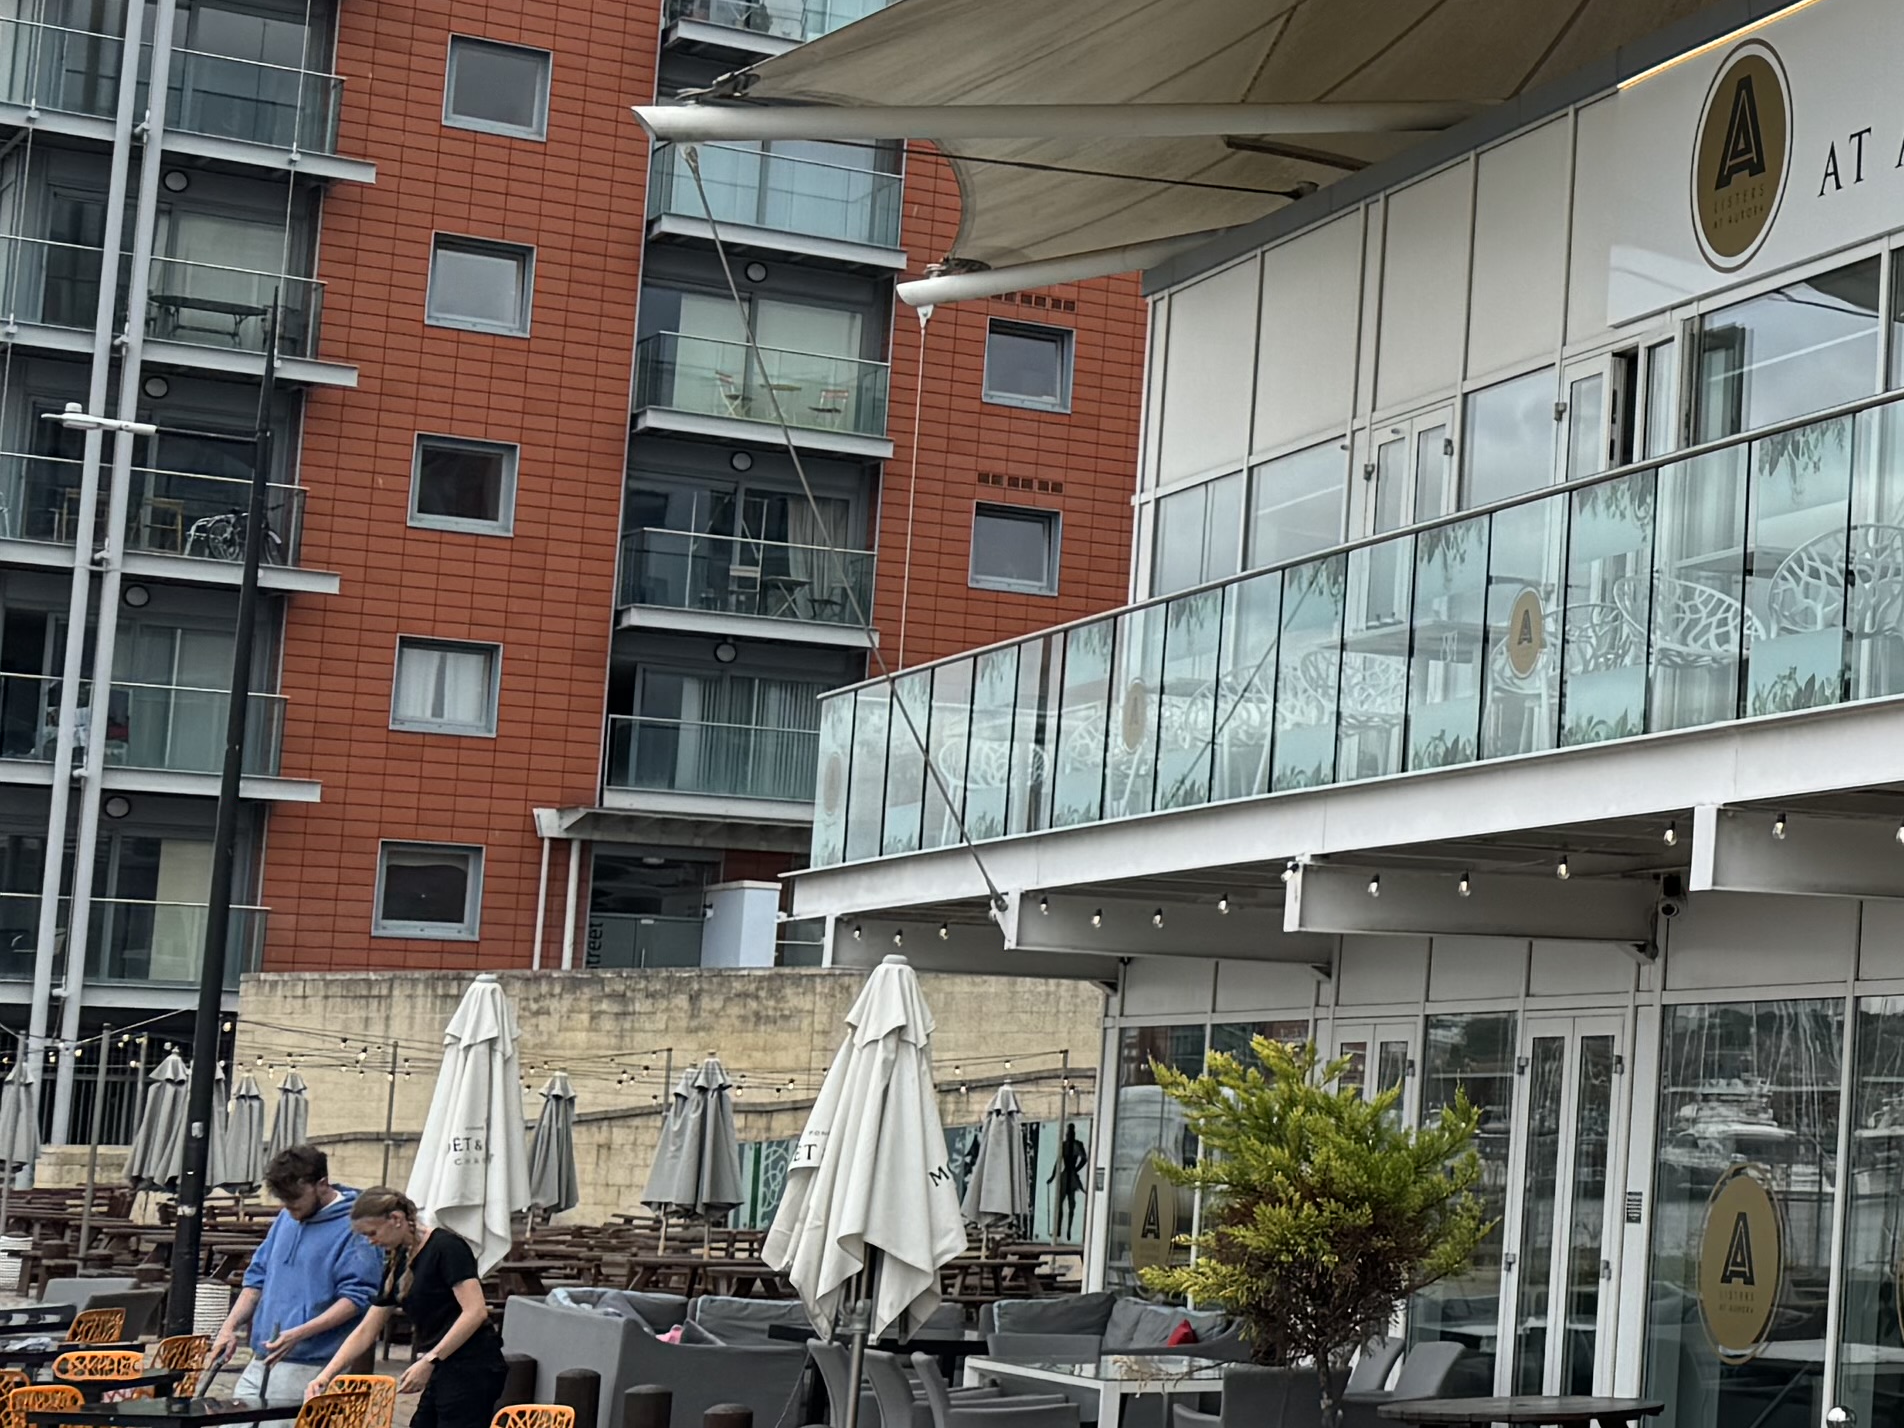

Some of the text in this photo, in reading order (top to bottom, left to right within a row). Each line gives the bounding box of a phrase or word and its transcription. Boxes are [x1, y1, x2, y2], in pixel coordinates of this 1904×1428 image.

[1714, 74, 1766, 191] A
[1817, 127, 1872, 198] AT
[586, 921, 604, 969] treet
[929, 1160, 952, 1187] M
[1141, 1184, 1160, 1240] A
[1720, 1211, 1755, 1286] A
